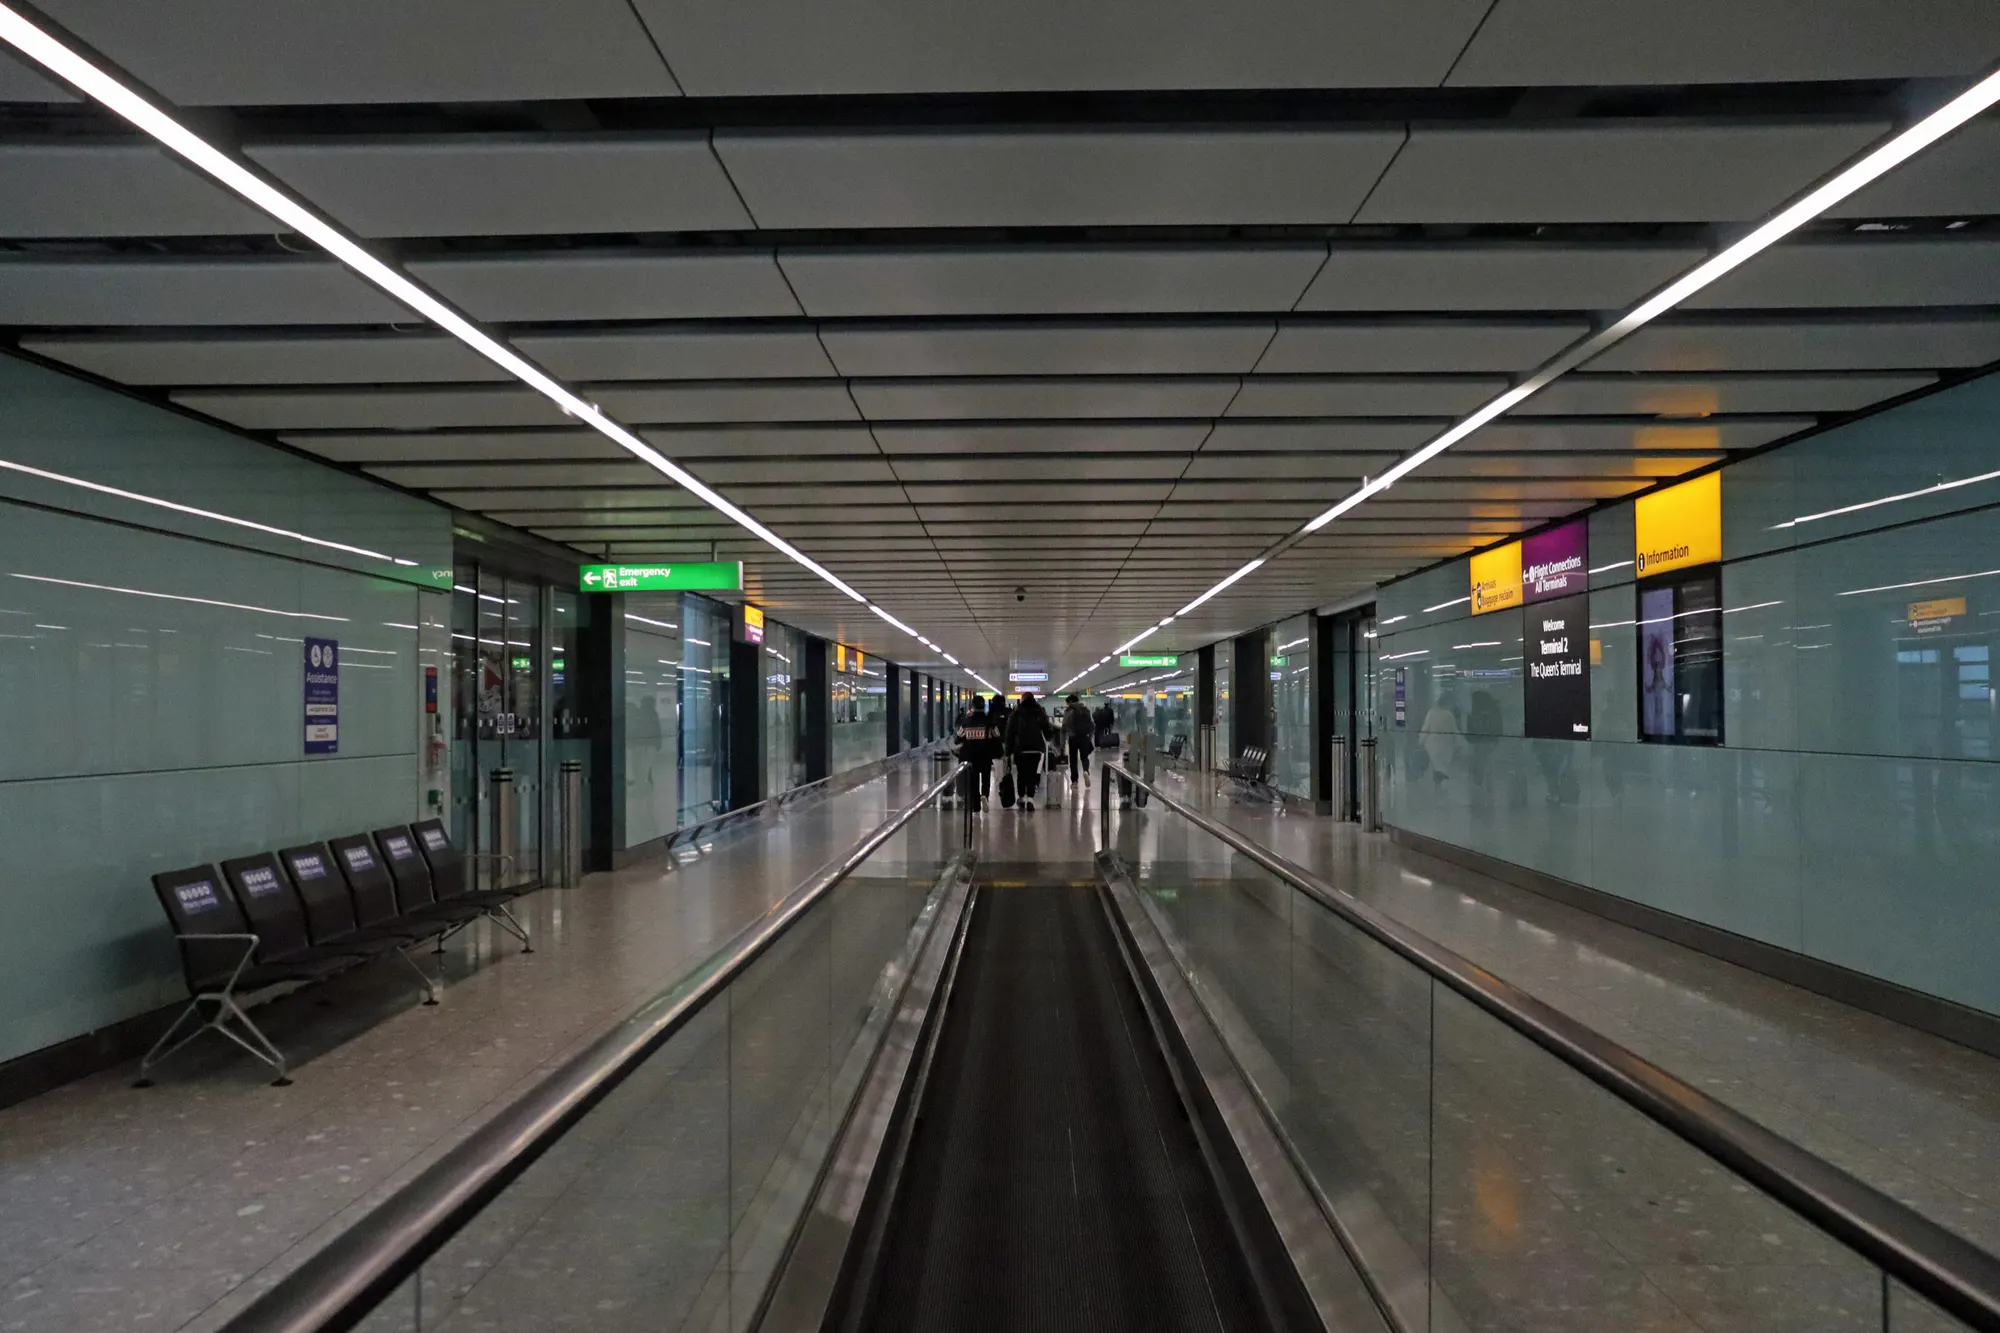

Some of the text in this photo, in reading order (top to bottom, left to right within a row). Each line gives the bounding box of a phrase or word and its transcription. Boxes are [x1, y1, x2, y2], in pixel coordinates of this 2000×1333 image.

[1646, 544, 1689, 566] Information
[619, 567, 671, 578] Emergency
[1534, 556, 1581, 579] Flight Connections
[619, 577, 638, 587] exit
[1542, 575, 1567, 591] Terminals
[1498, 588, 1514, 602] reclaim
[1542, 619, 1565, 632] Welcome
[1540, 637, 1568, 655] Terminal 2
[1530, 662, 1539, 677] The
[1559, 658, 1582, 676] Terminal
